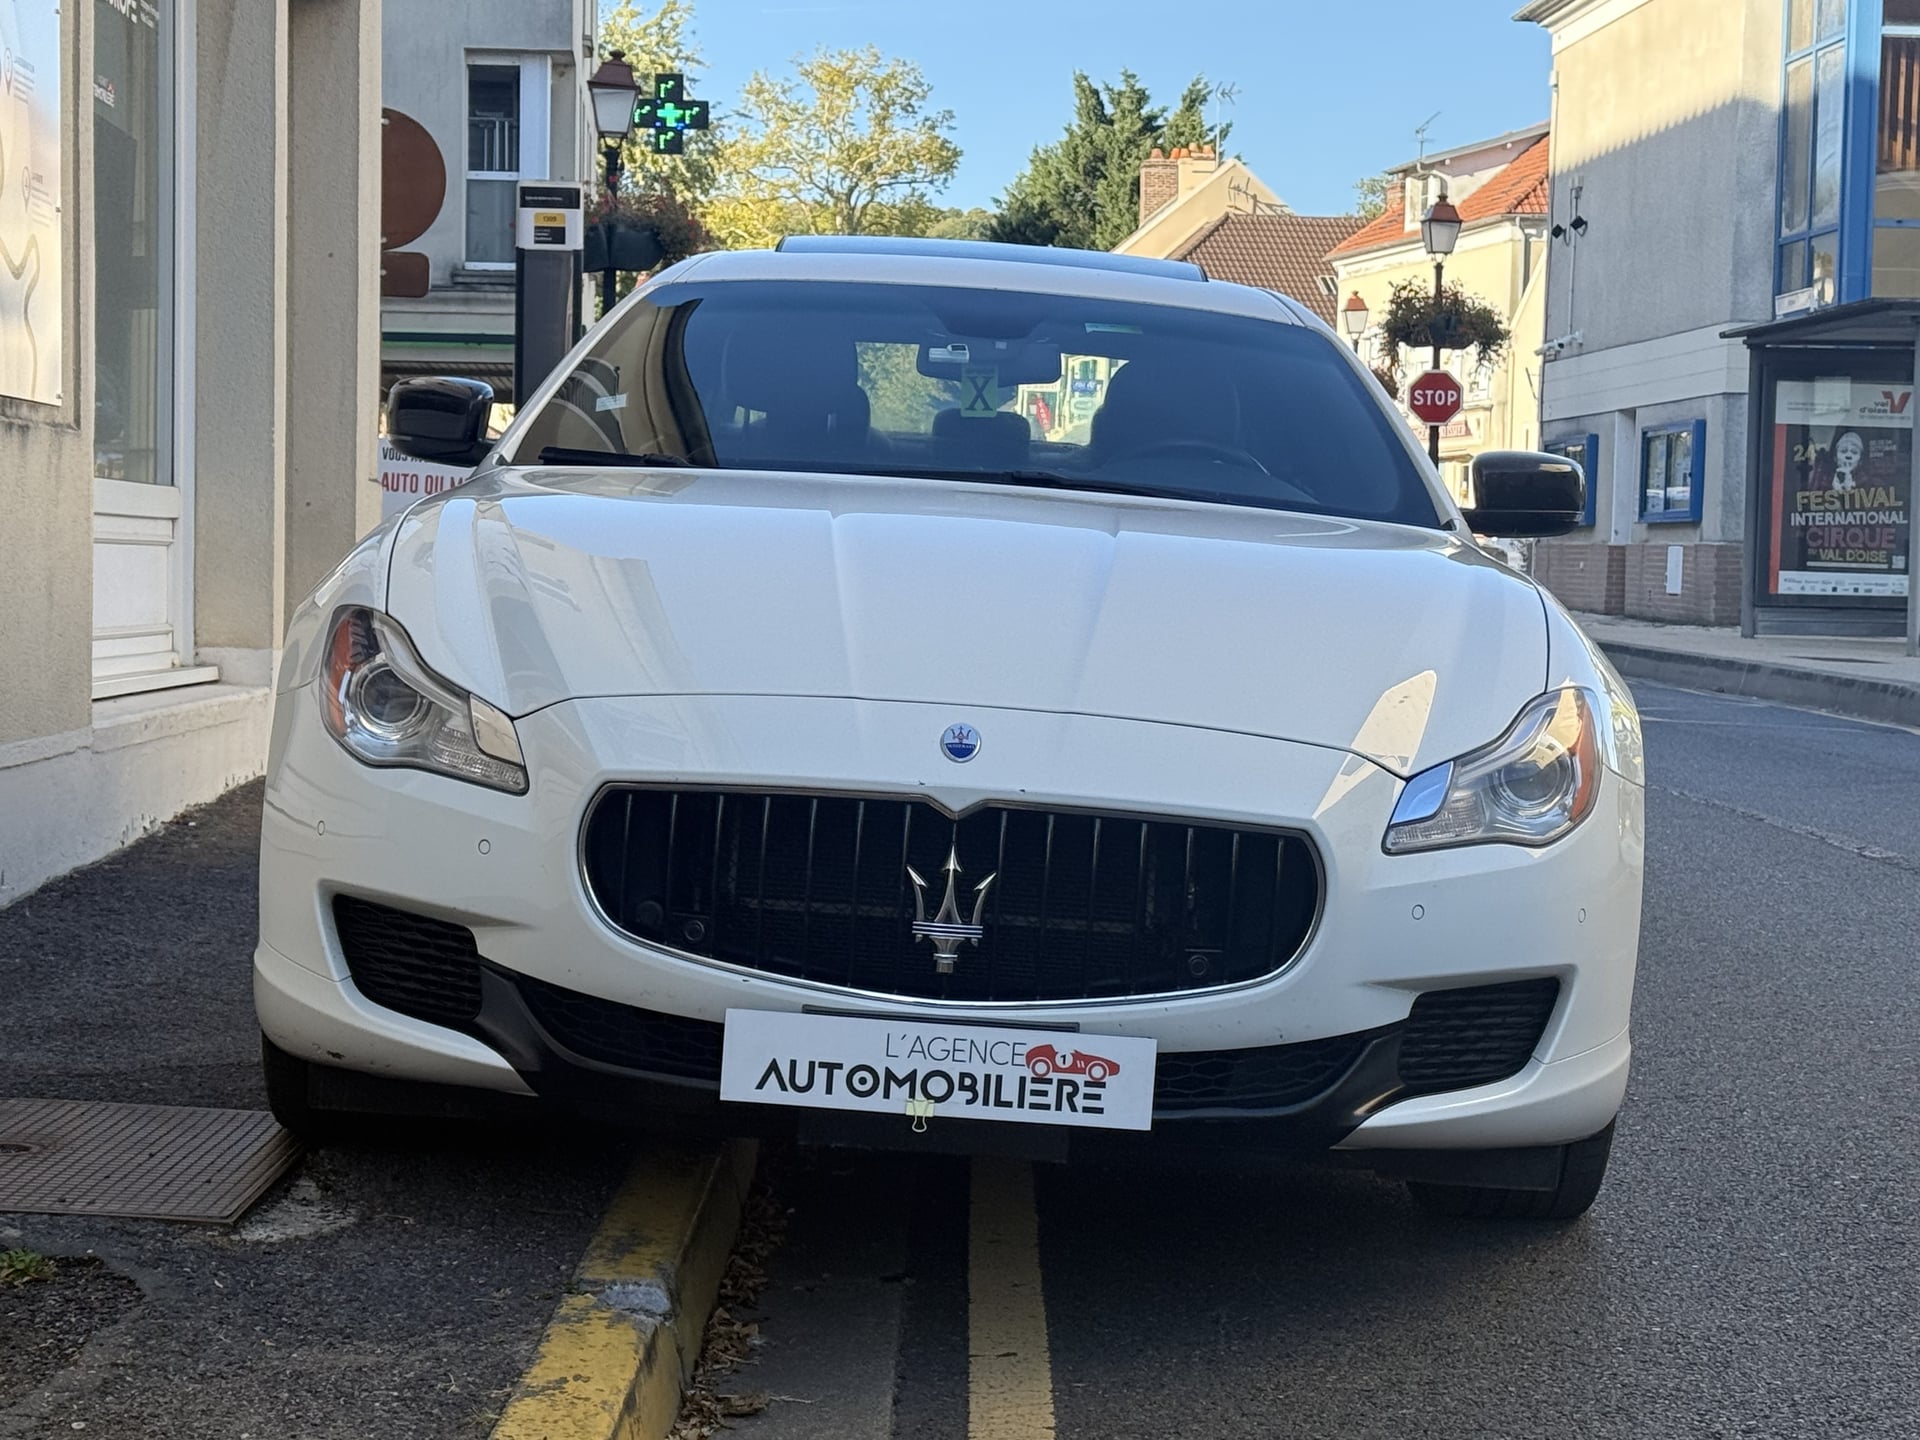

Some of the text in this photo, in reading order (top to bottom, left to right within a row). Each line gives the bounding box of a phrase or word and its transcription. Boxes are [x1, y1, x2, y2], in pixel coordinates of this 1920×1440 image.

[965, 375, 994, 412] X
[1413, 389, 1458, 406] STOP
[382, 471, 418, 493] AUTO
[1796, 487, 1904, 512] FESTIVAL
[1790, 511, 1908, 526] INTERNATIONAL
[1806, 527, 1897, 549] CIRQUE
[1819, 549, 1844, 561] VAL
[1846, 549, 1888, 563] D'OISE
[885, 1032, 1028, 1068] L'AGENCE
[1059, 1053, 1068, 1066] 1
[754, 1057, 1107, 1115] AUTOMOBILIERE
